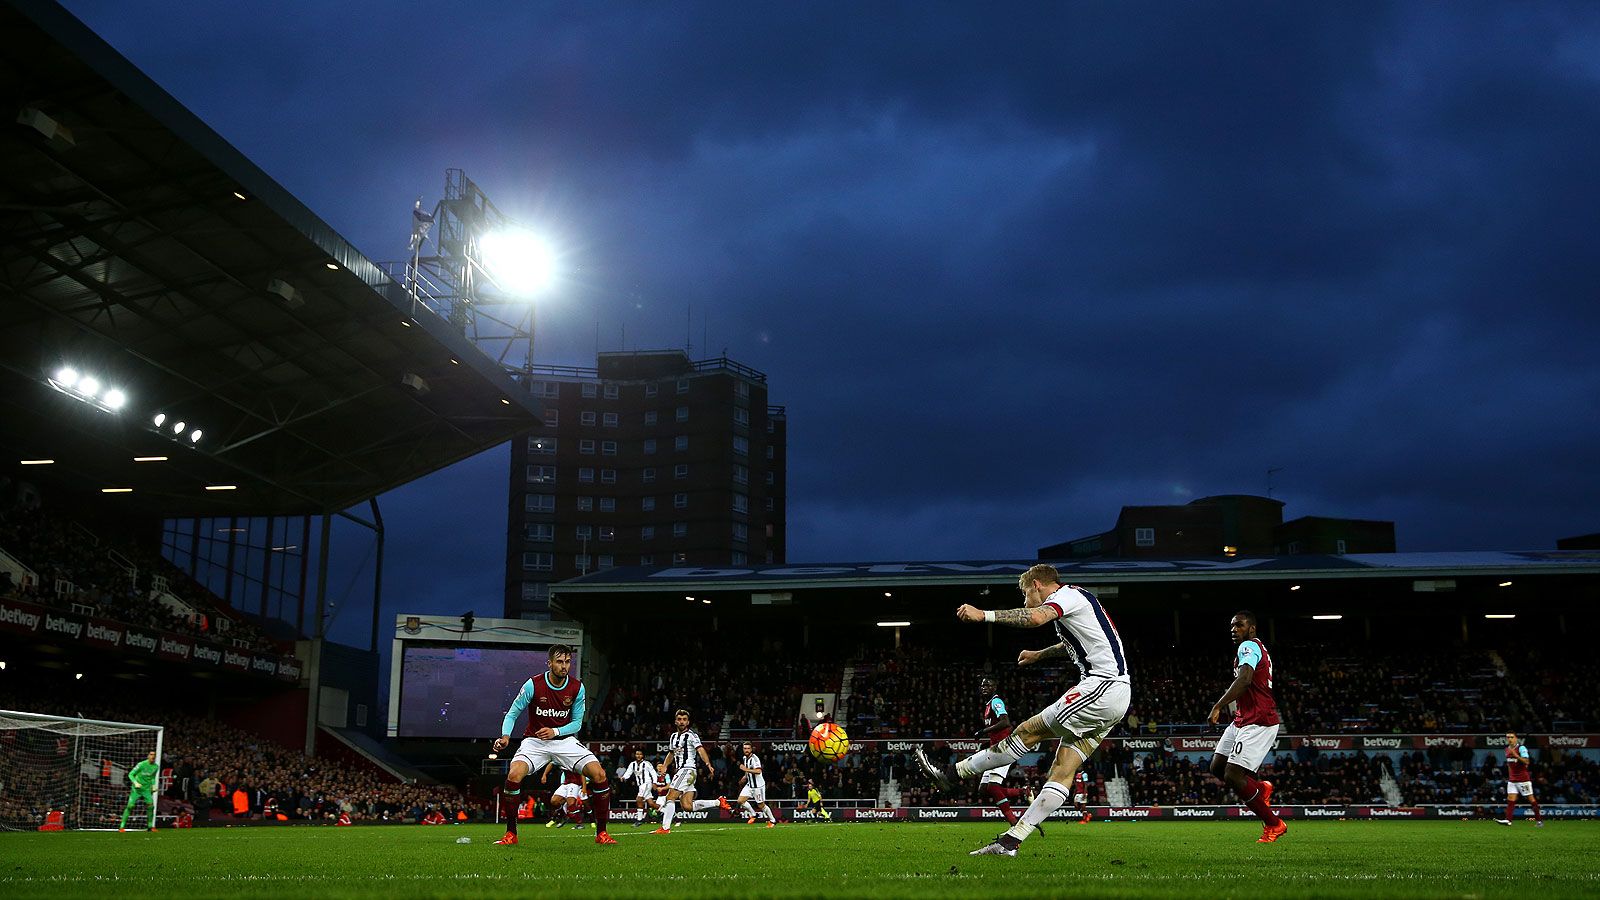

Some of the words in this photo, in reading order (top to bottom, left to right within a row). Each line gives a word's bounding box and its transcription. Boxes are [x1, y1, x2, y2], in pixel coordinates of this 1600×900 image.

[0, 605, 40, 632] betway
[45, 614, 82, 639] betway
[87, 622, 121, 646] betway
[126, 630, 157, 653] betway
[161, 637, 190, 659] betway
[194, 644, 221, 665] betway
[224, 650, 250, 670] betway
[253, 656, 276, 675] betway
[278, 661, 300, 680] betway
[536, 706, 570, 719] betway
[1363, 737, 1401, 748] betway
[1548, 736, 1588, 747] betway
